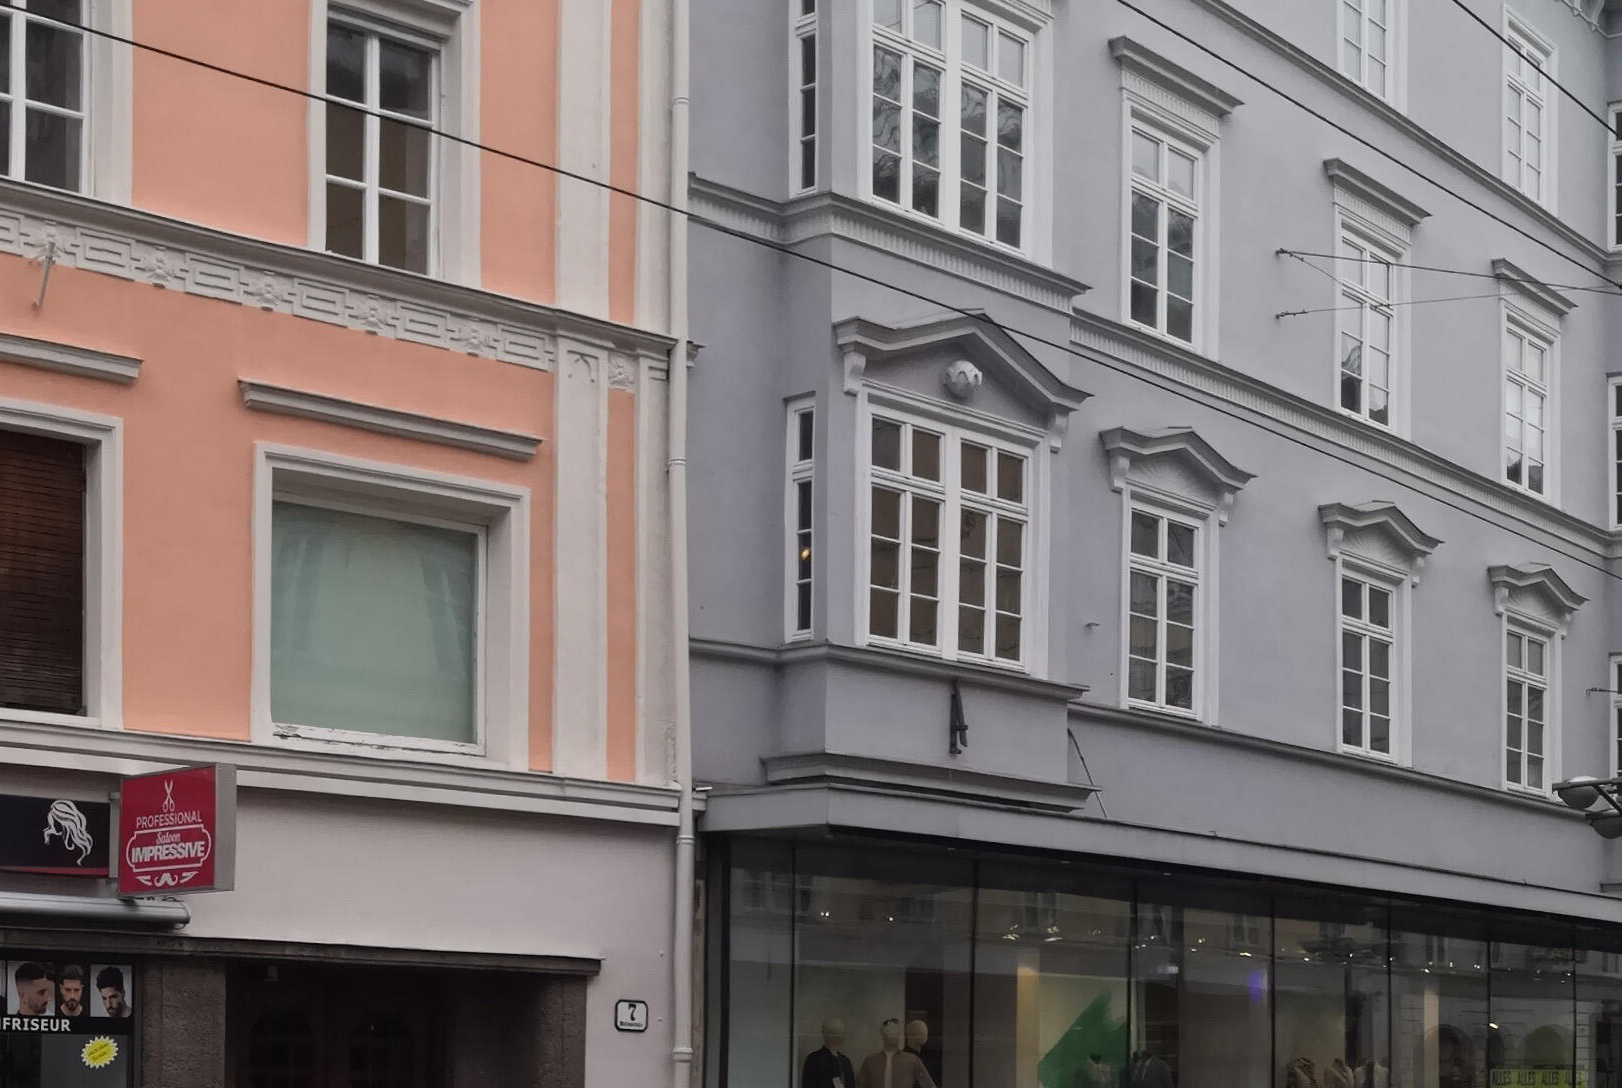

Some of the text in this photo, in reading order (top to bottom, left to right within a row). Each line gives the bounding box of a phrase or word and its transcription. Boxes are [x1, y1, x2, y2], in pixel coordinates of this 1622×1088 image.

[135, 810, 203, 829] PROFESSIONAL
[131, 841, 206, 863] IMPRESSIVE
[628, 1003, 637, 1022] 7
